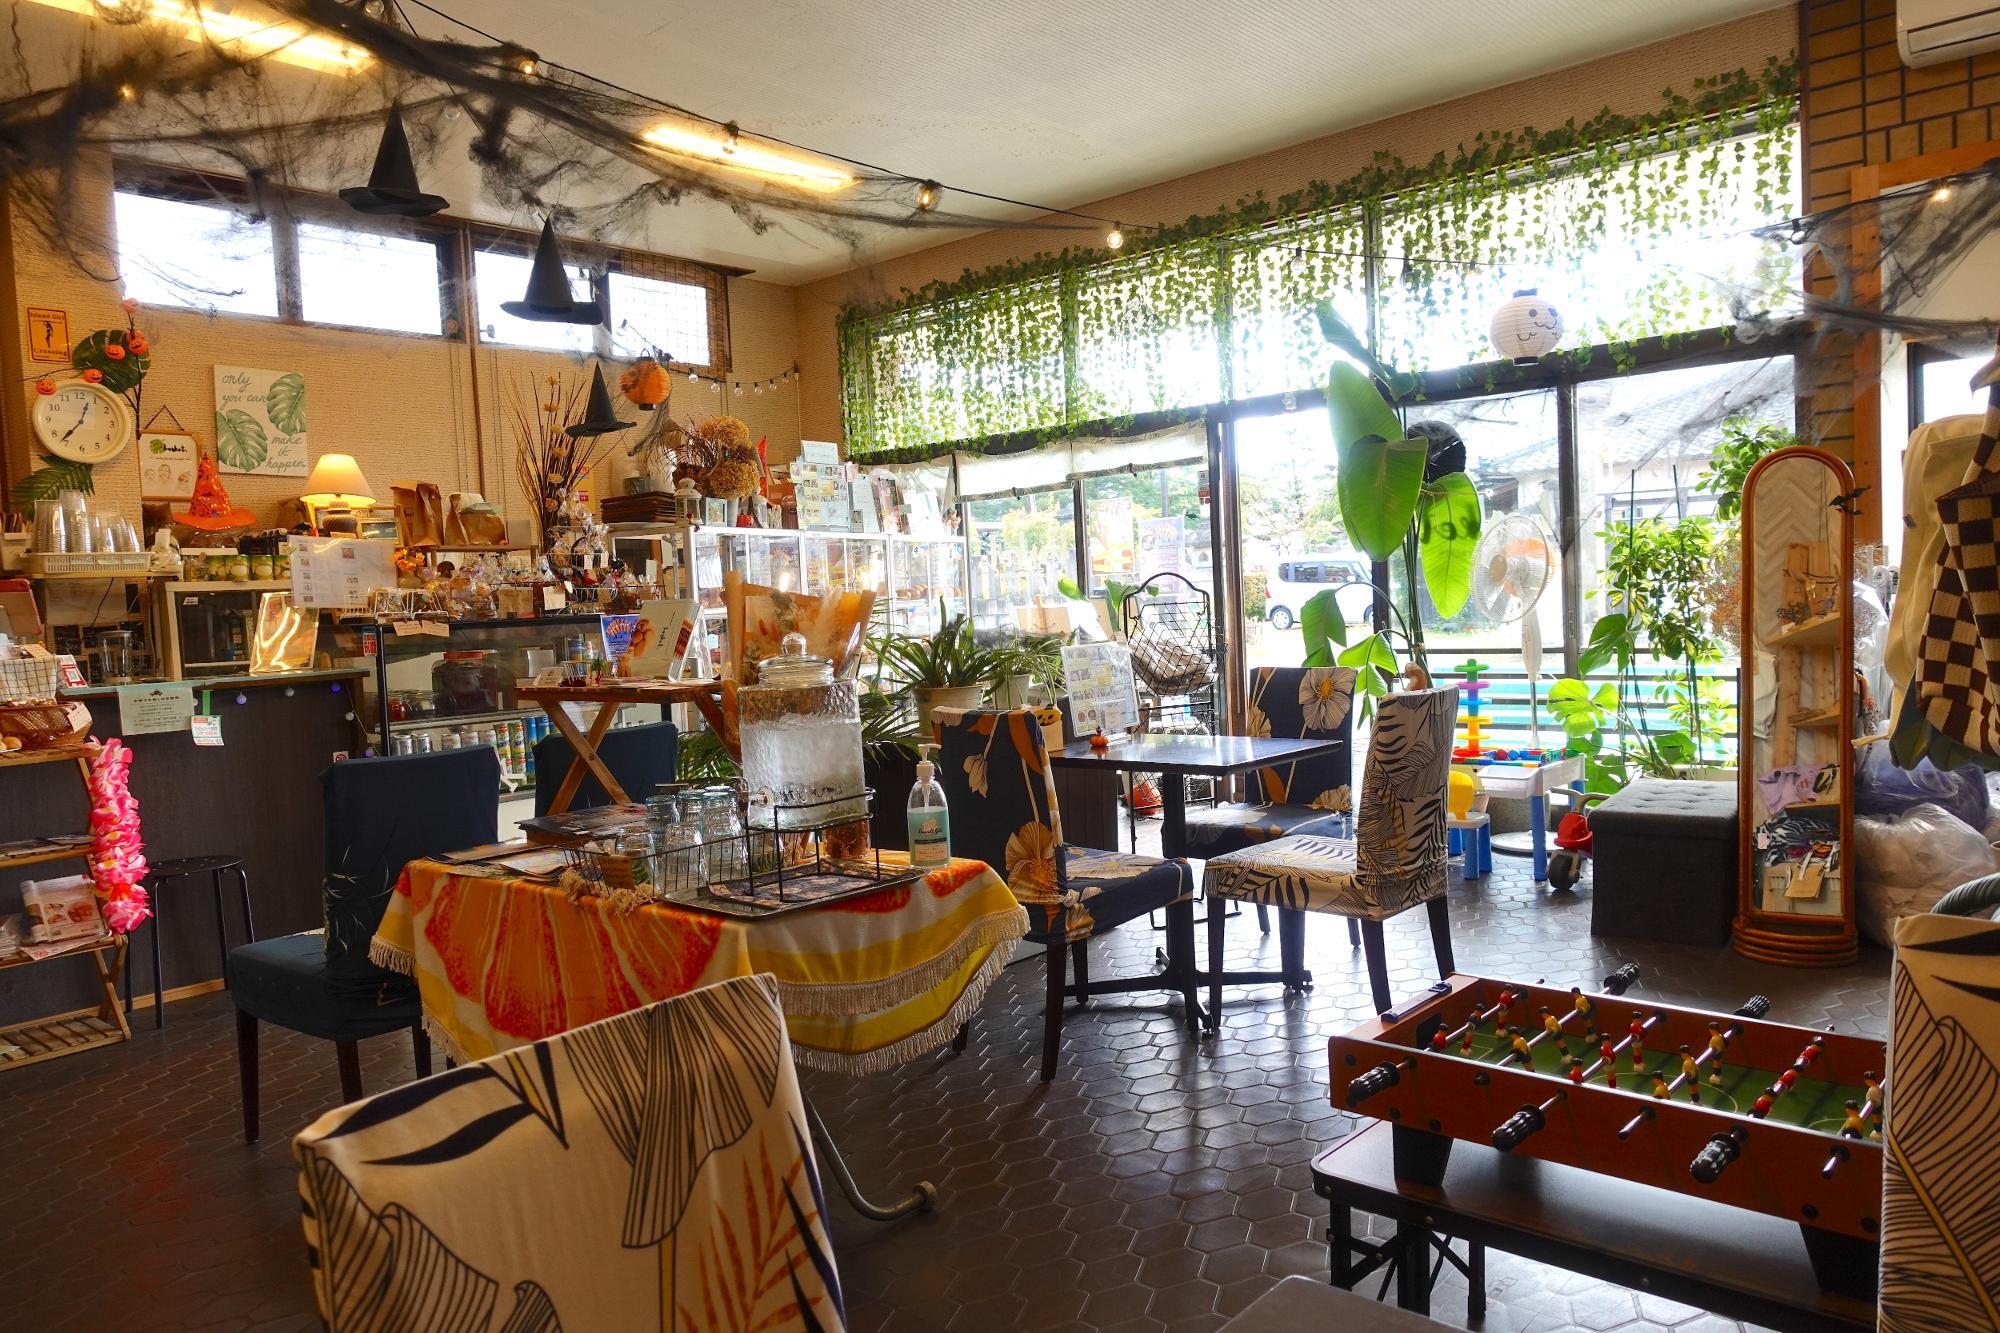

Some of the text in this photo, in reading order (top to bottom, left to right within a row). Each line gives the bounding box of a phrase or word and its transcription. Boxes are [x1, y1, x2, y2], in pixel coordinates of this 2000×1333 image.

[33, 348, 67, 357] Crossing
[222, 372, 252, 392] only
[60, 394, 70, 402] 11
[75, 392, 85, 400] 12
[220, 394, 268, 410] you can
[49, 403, 60, 411] 10
[103, 406, 109, 414] 2
[271, 436, 303, 445] make
[278, 446, 293, 457] it
[266, 457, 306, 473] happen
